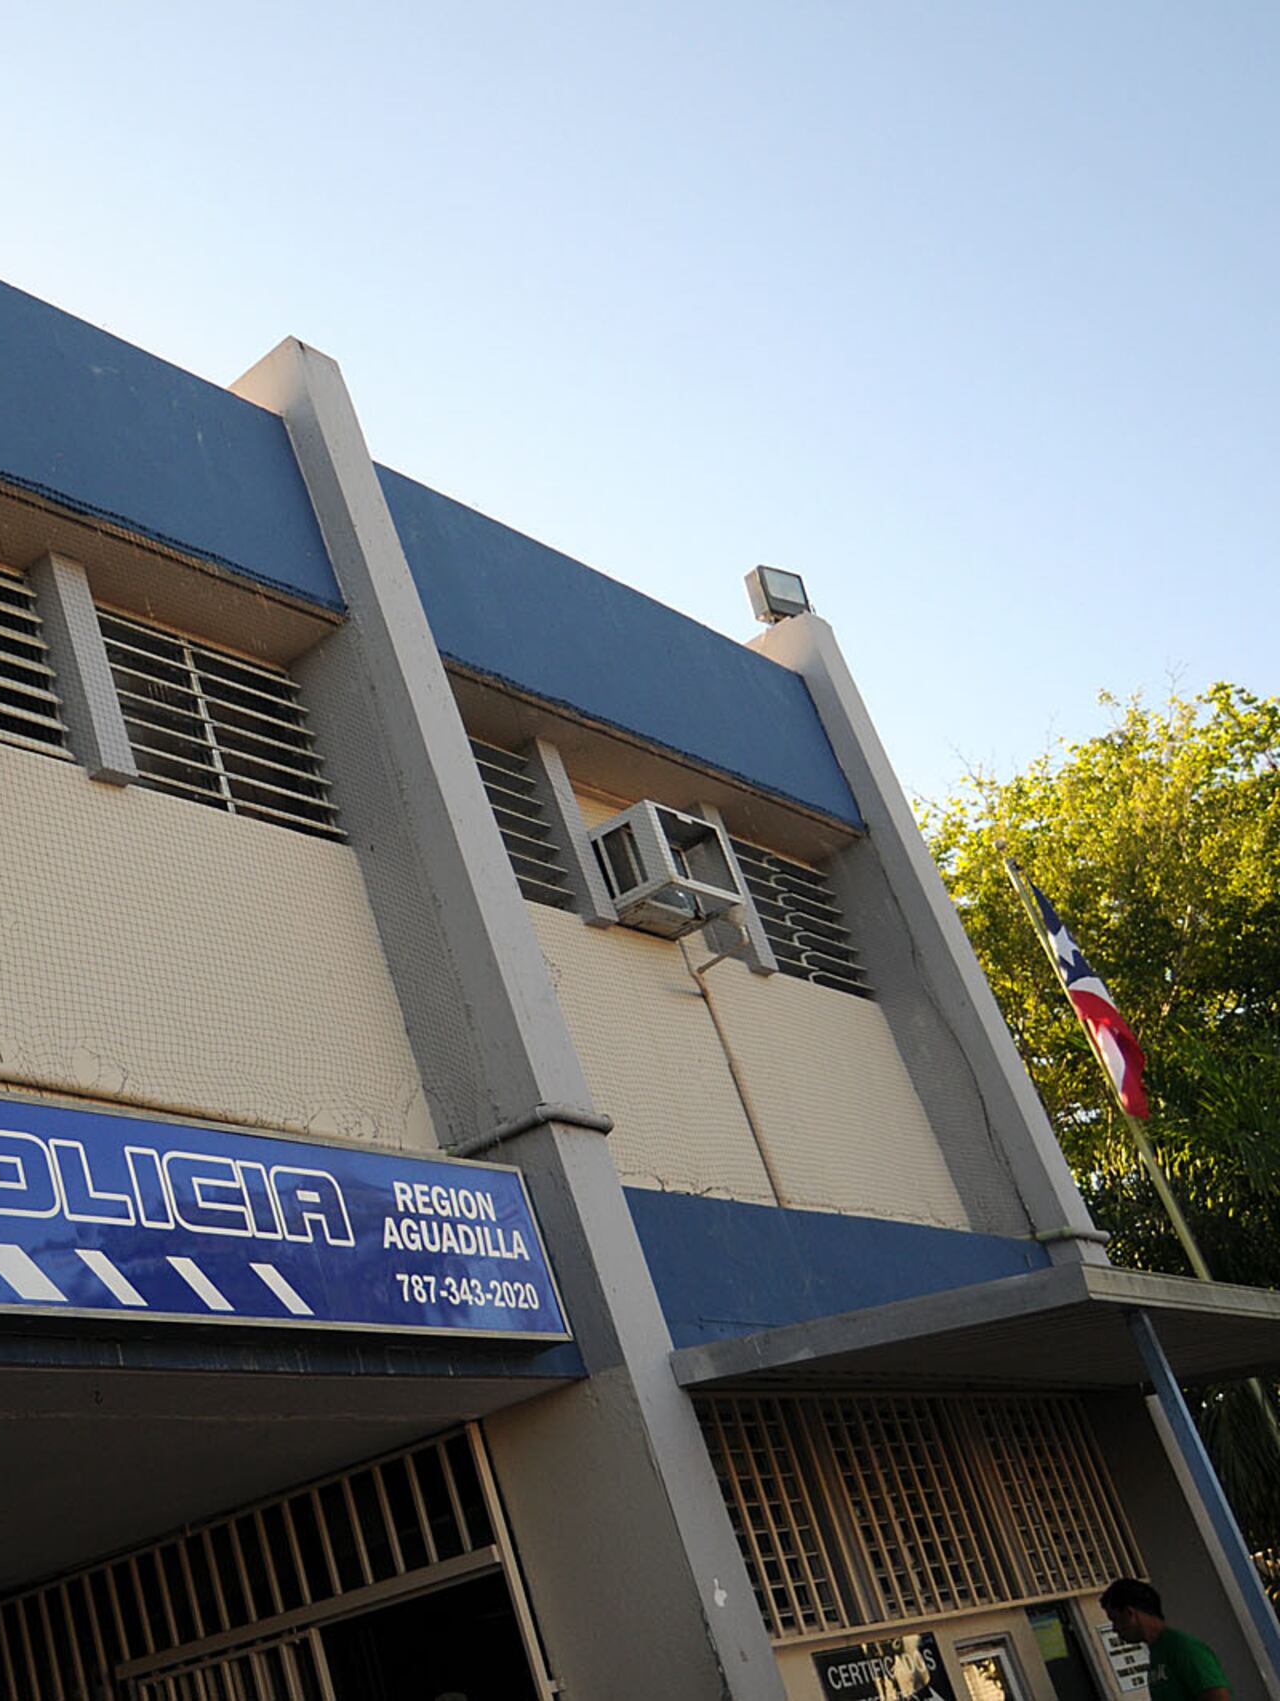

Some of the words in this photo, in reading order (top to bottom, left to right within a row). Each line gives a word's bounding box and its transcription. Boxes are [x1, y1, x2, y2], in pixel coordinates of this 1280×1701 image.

[392, 1180, 497, 1222] REGION
[383, 1216, 531, 1261] AGUADILLA
[395, 1272, 540, 1310] 787-343-2020
[826, 1648, 937, 1690] CERTIFICDOS
